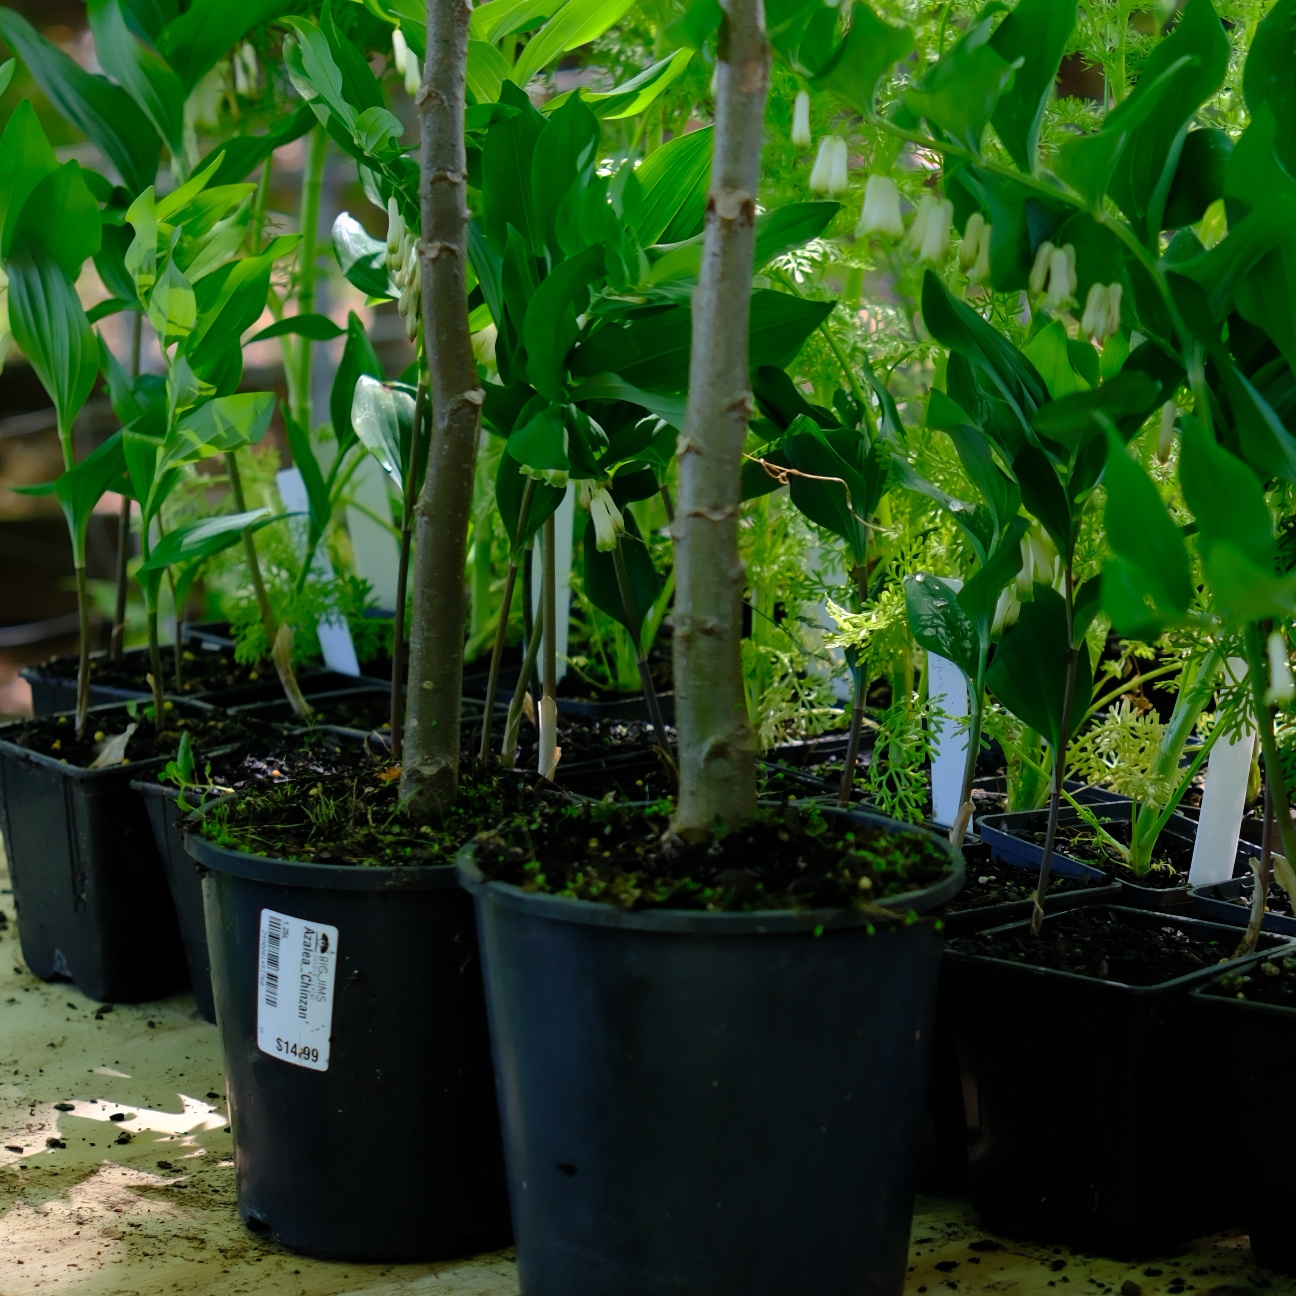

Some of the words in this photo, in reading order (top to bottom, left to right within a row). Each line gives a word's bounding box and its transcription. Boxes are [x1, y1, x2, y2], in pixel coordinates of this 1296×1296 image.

[302, 926, 315, 966] Azalea
[315, 975, 327, 1003] JIMS
[276, 1037, 319, 1063] $14.99
